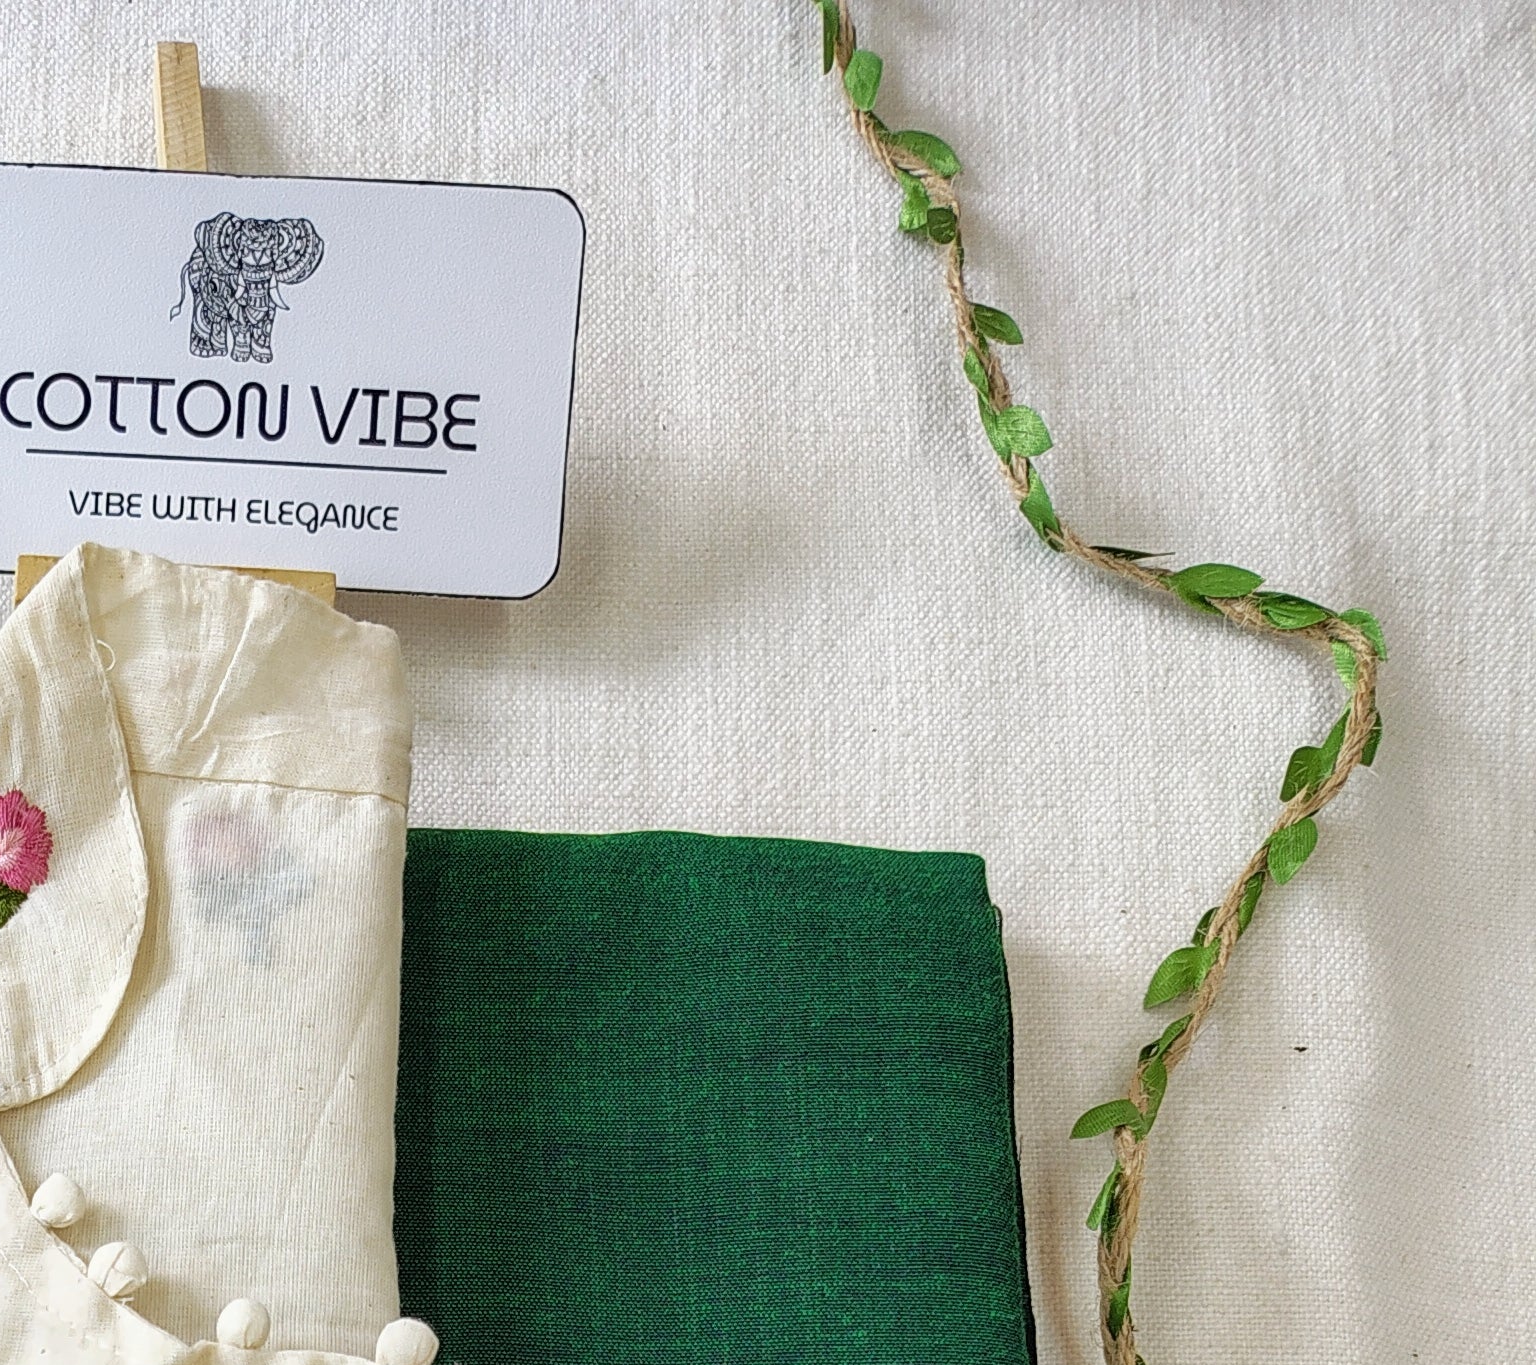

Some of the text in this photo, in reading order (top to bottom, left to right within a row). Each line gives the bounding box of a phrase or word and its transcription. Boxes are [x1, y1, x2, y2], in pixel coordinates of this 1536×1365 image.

[309, 384, 481, 453] VIBE
[68, 489, 399, 534] VIBE WITH ELEGANCE
